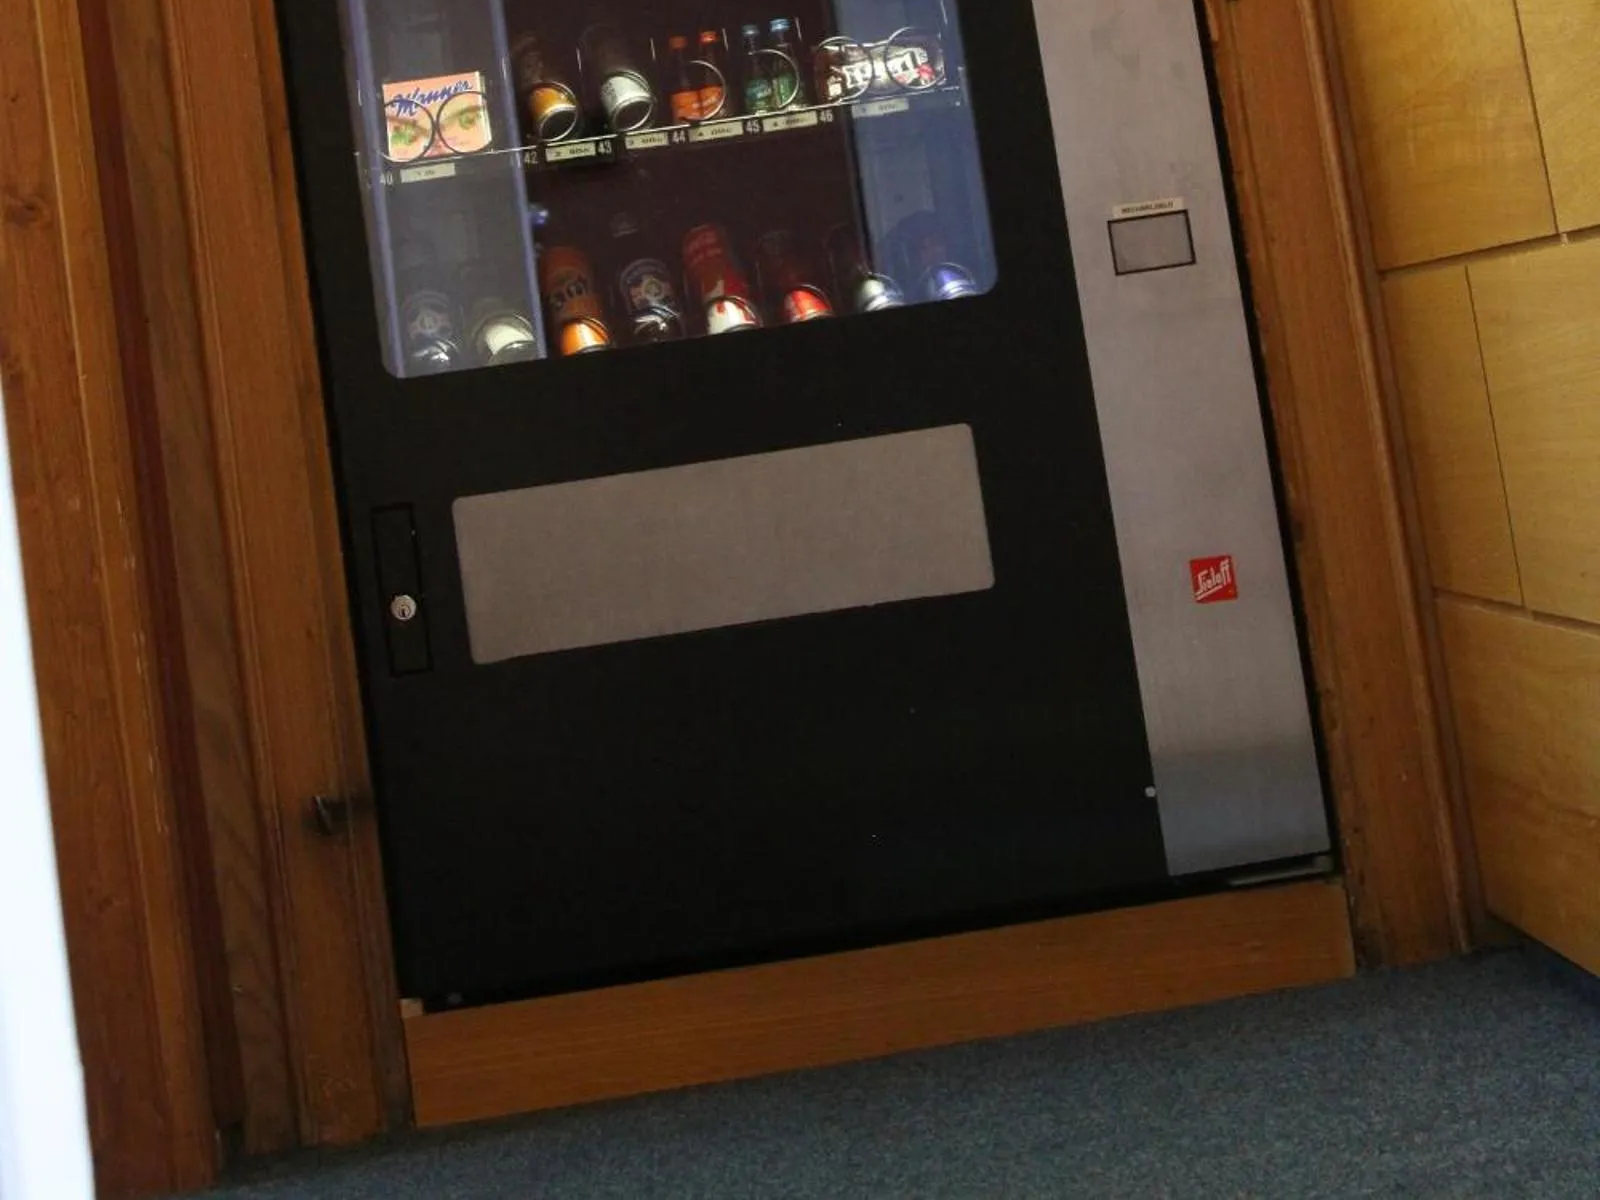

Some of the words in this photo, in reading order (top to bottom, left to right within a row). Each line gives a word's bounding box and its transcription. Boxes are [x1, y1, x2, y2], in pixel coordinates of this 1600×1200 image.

[820, 108, 833, 123] 46
[744, 119, 760, 134] 45
[671, 129, 686, 144] 44
[524, 151, 538, 164] 42
